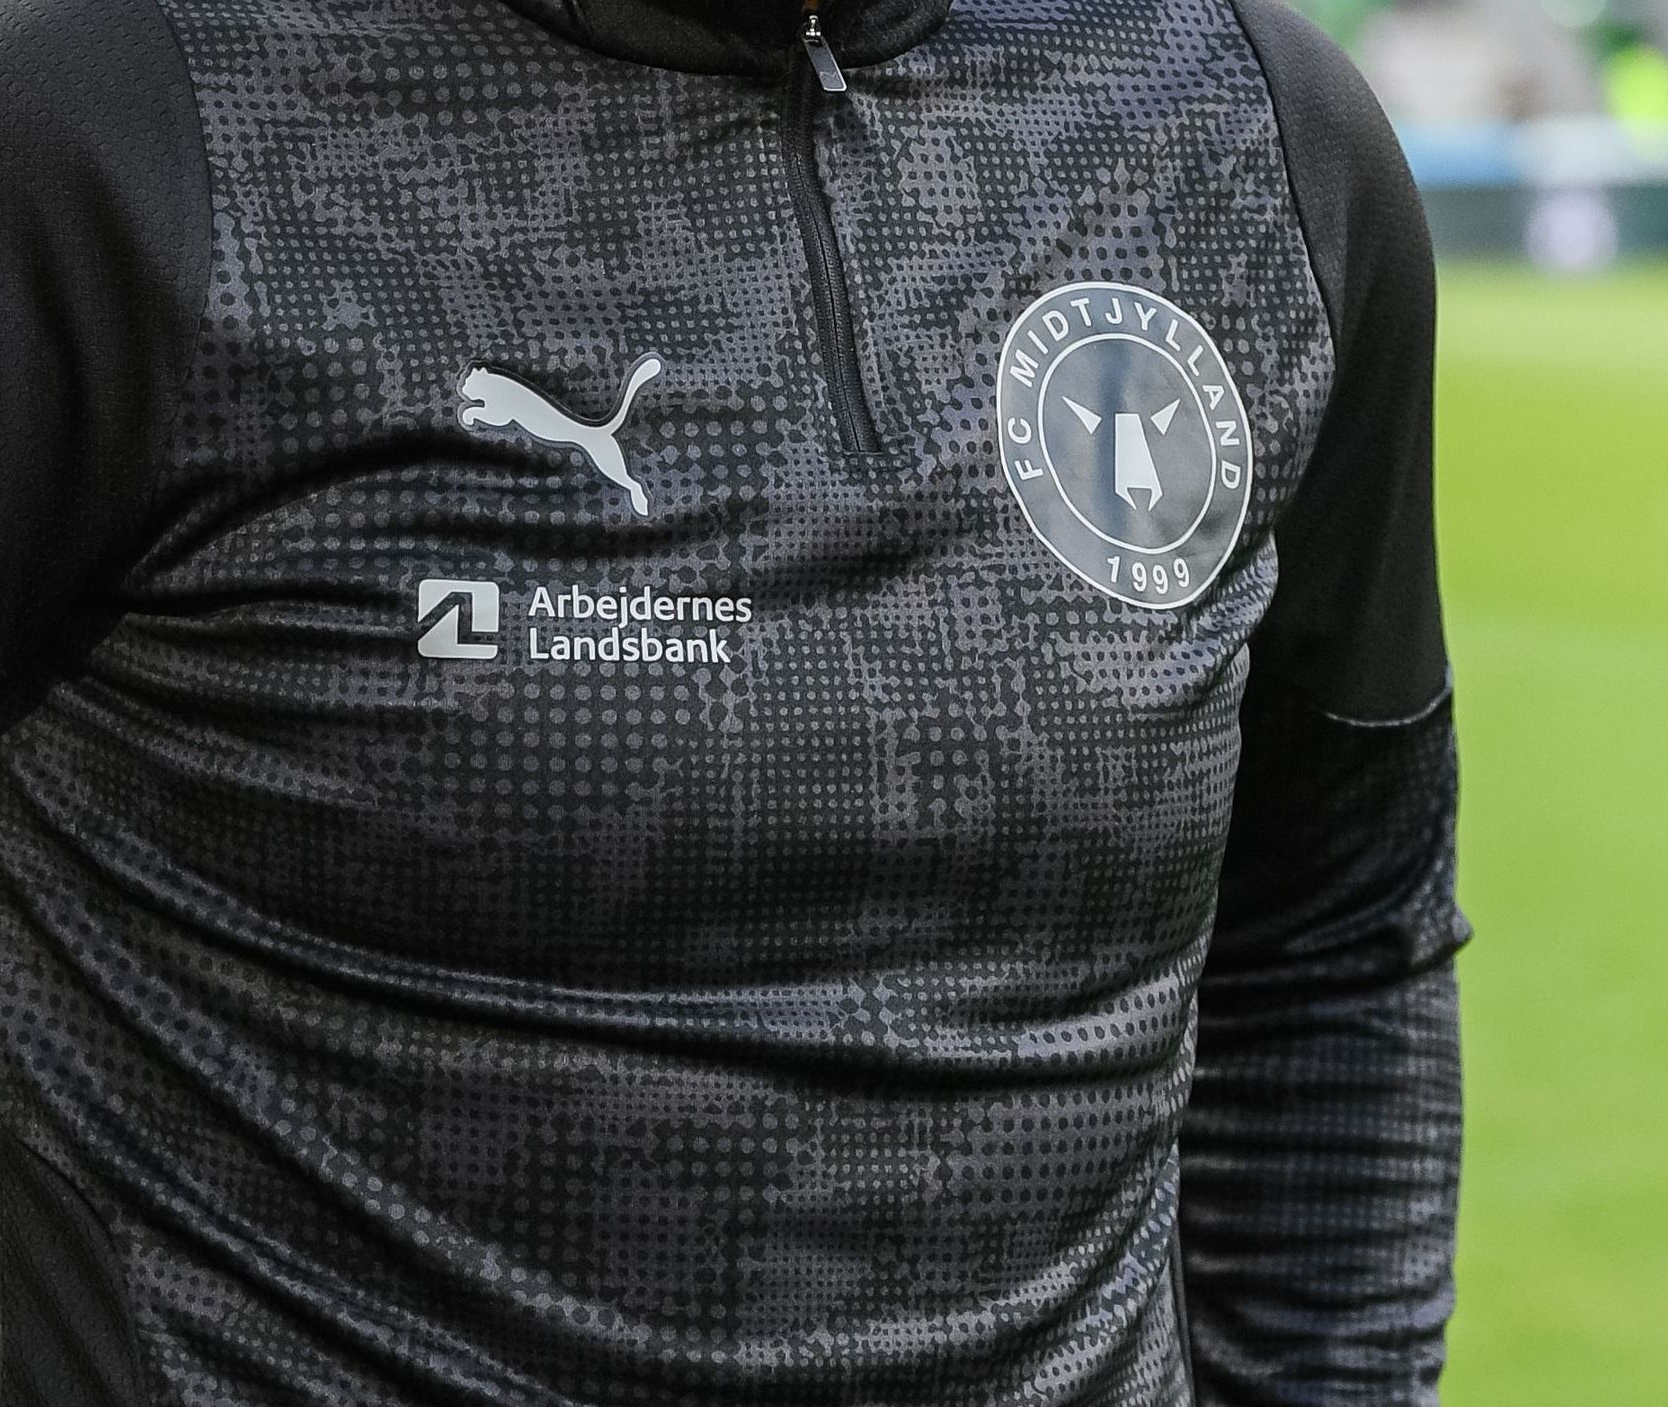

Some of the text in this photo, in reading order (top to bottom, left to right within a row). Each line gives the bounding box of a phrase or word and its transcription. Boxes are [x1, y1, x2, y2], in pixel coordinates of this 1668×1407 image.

[1007, 297, 1242, 490] FC MIDTJYLLAND
[1107, 555, 1190, 595] 1999
[528, 584, 753, 629] Arbejdernes
[529, 627, 731, 663] Landsbank
